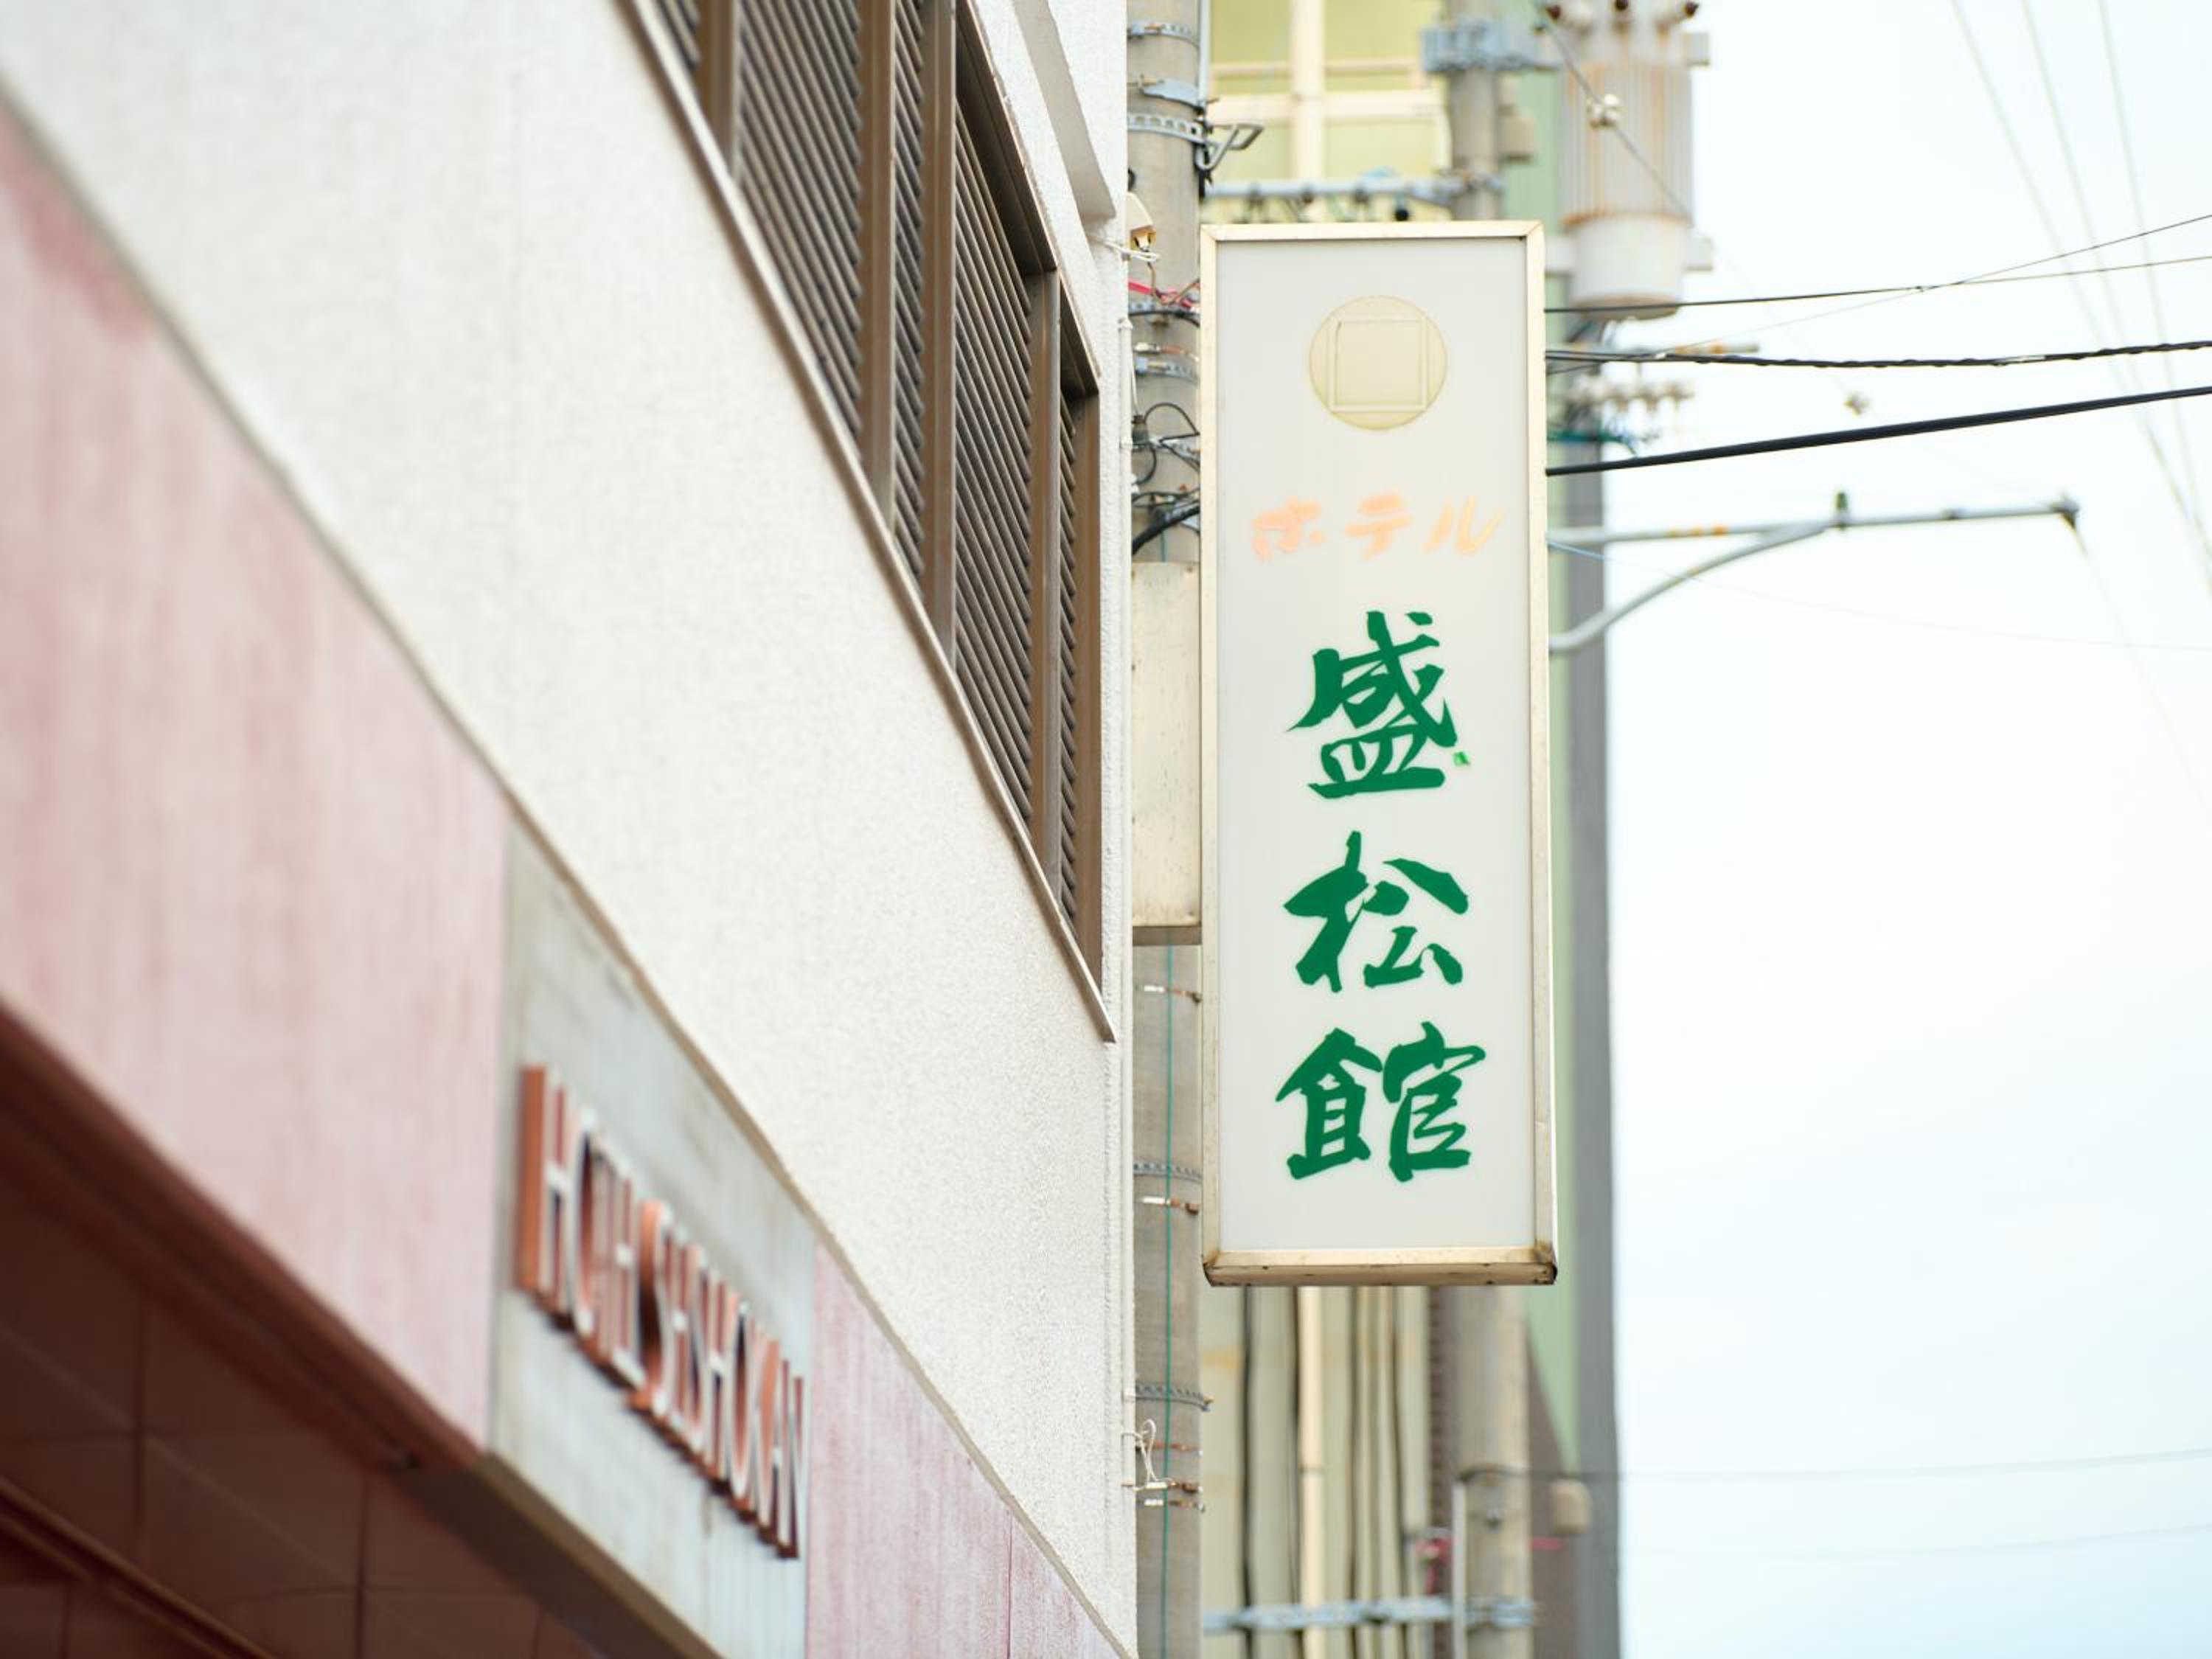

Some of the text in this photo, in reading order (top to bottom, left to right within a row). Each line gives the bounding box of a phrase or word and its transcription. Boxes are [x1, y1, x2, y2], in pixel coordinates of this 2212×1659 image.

[1251, 490, 1505, 562] ホテル
[1276, 611, 1486, 1182] 盛松館
